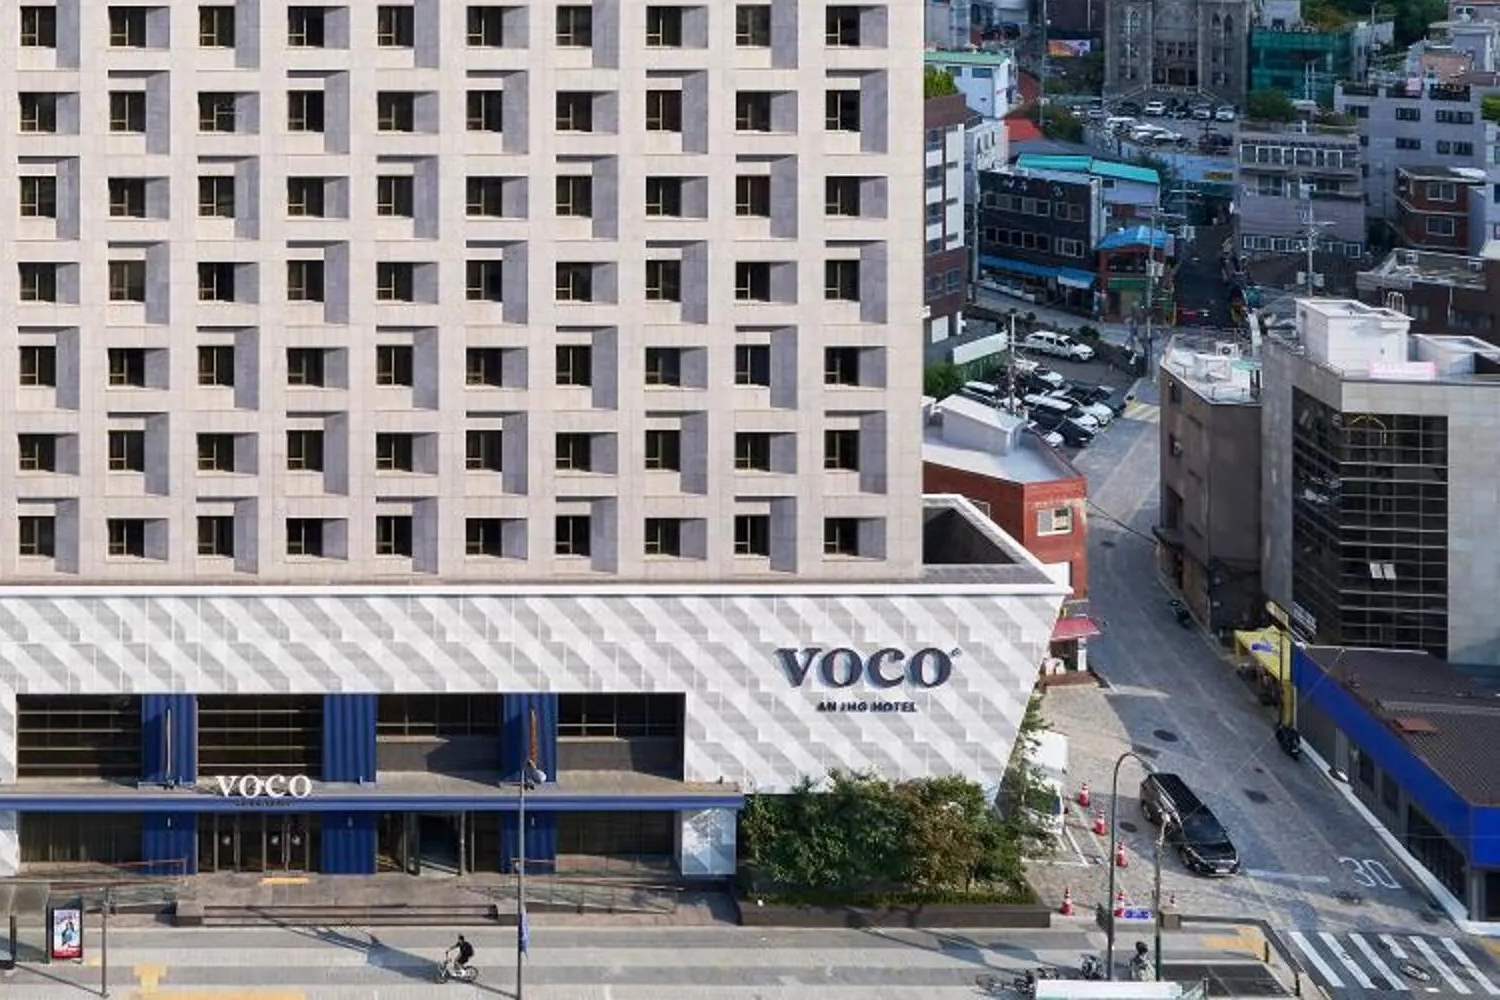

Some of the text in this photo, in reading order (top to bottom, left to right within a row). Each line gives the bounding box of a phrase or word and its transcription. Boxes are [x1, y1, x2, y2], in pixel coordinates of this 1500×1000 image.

[817, 701, 918, 713] AN IHG HOTEL
[1338, 856, 1403, 889] 30
